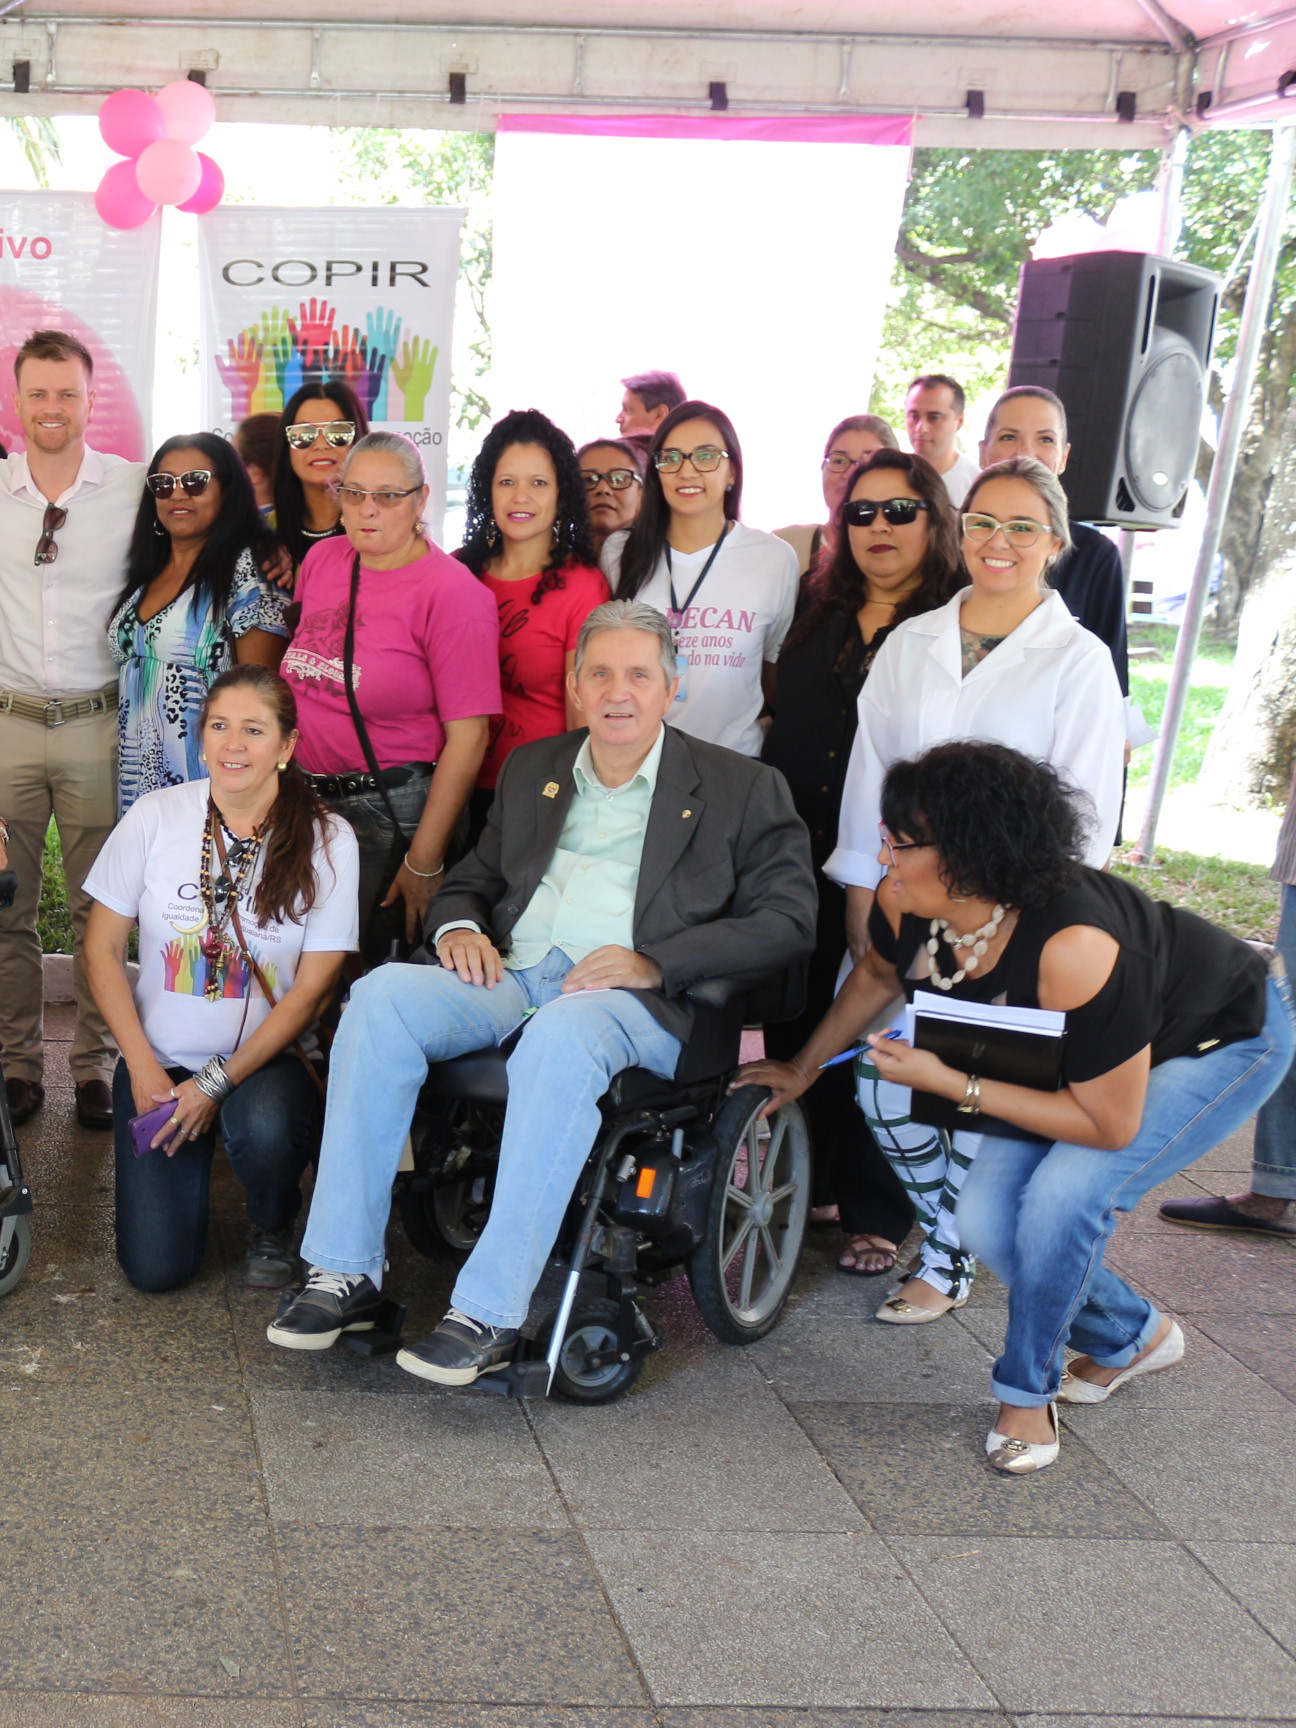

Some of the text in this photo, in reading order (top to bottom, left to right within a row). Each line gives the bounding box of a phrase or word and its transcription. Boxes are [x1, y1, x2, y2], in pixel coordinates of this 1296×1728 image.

[221, 258, 431, 287] COPIR
[672, 635, 734, 649] eze anos
[704, 653, 720, 666] na
[723, 651, 746, 668] vida
[162, 912, 200, 923] Igualdade
[269, 925, 280, 934] de
